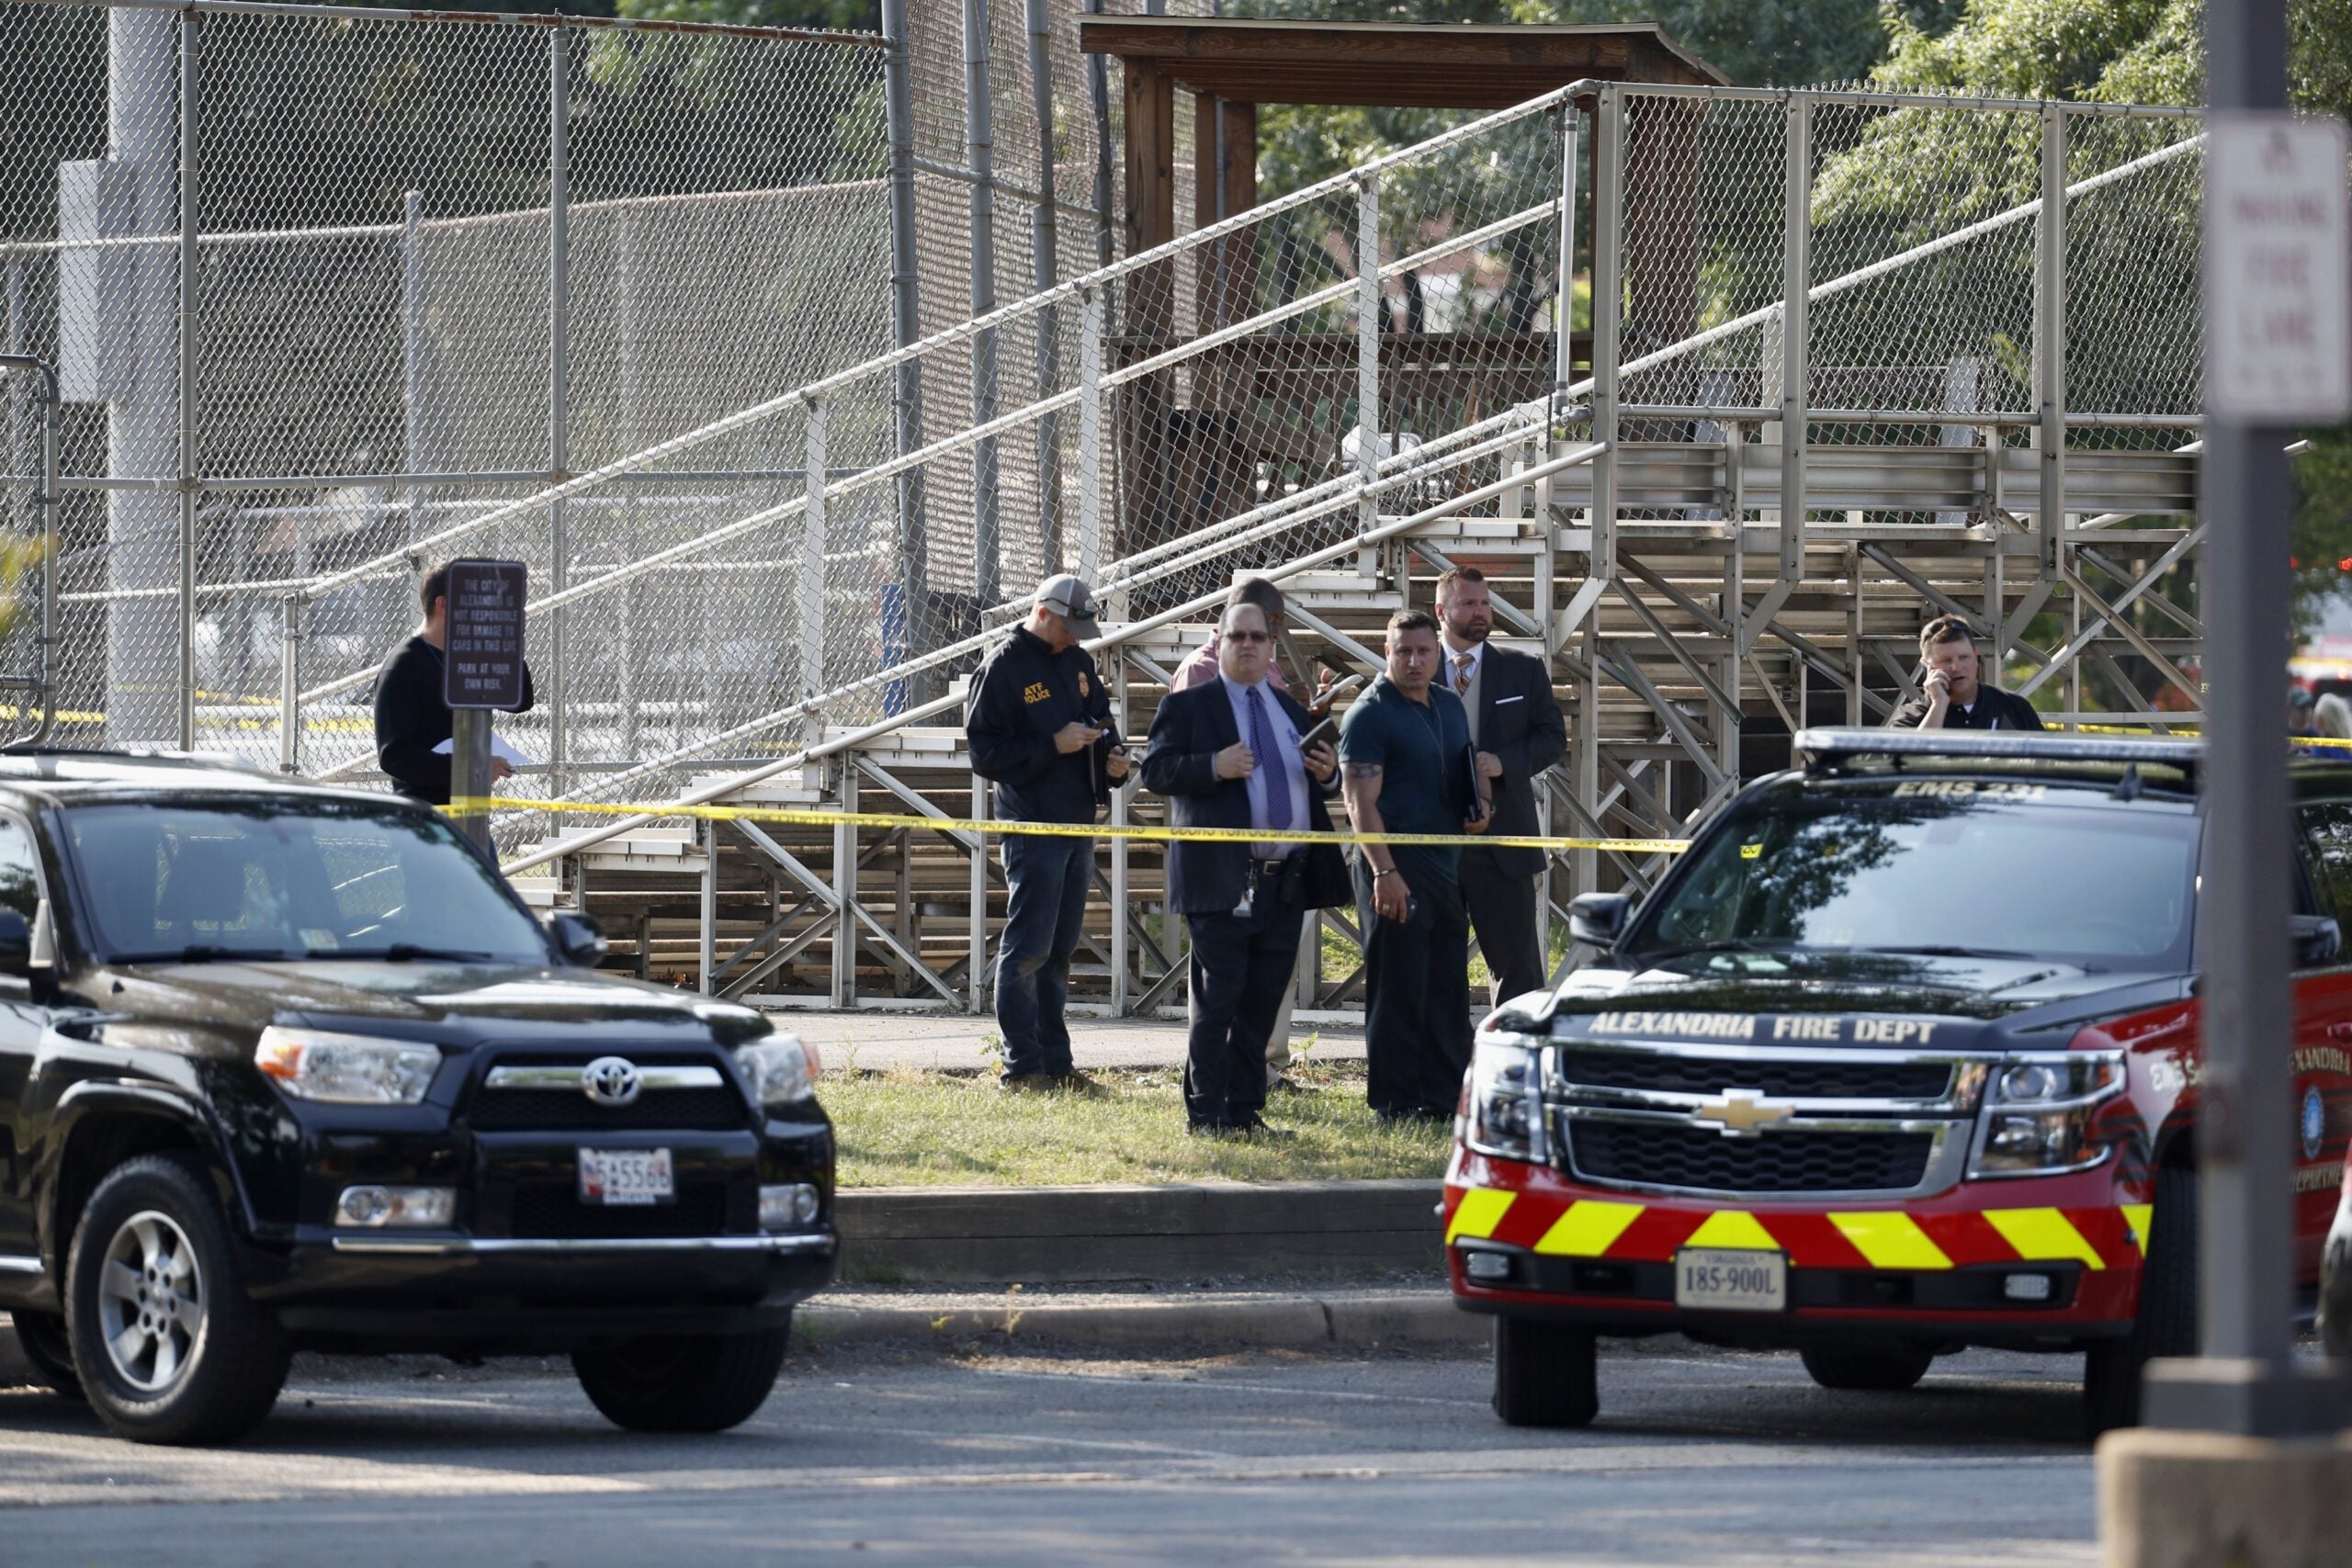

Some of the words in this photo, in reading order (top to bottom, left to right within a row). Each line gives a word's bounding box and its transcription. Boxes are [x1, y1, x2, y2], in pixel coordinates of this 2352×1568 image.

[1024, 690, 1051, 704] POLICE
[1025, 682, 1043, 695] ATF
[1894, 781, 1975, 799] EMS
[1589, 1011, 1756, 1037] ALEXANDRIA
[1773, 1016, 1841, 1040] FIRE
[1854, 1019, 1937, 1044] DEPT
[1686, 1266, 1776, 1294] 185-900L
